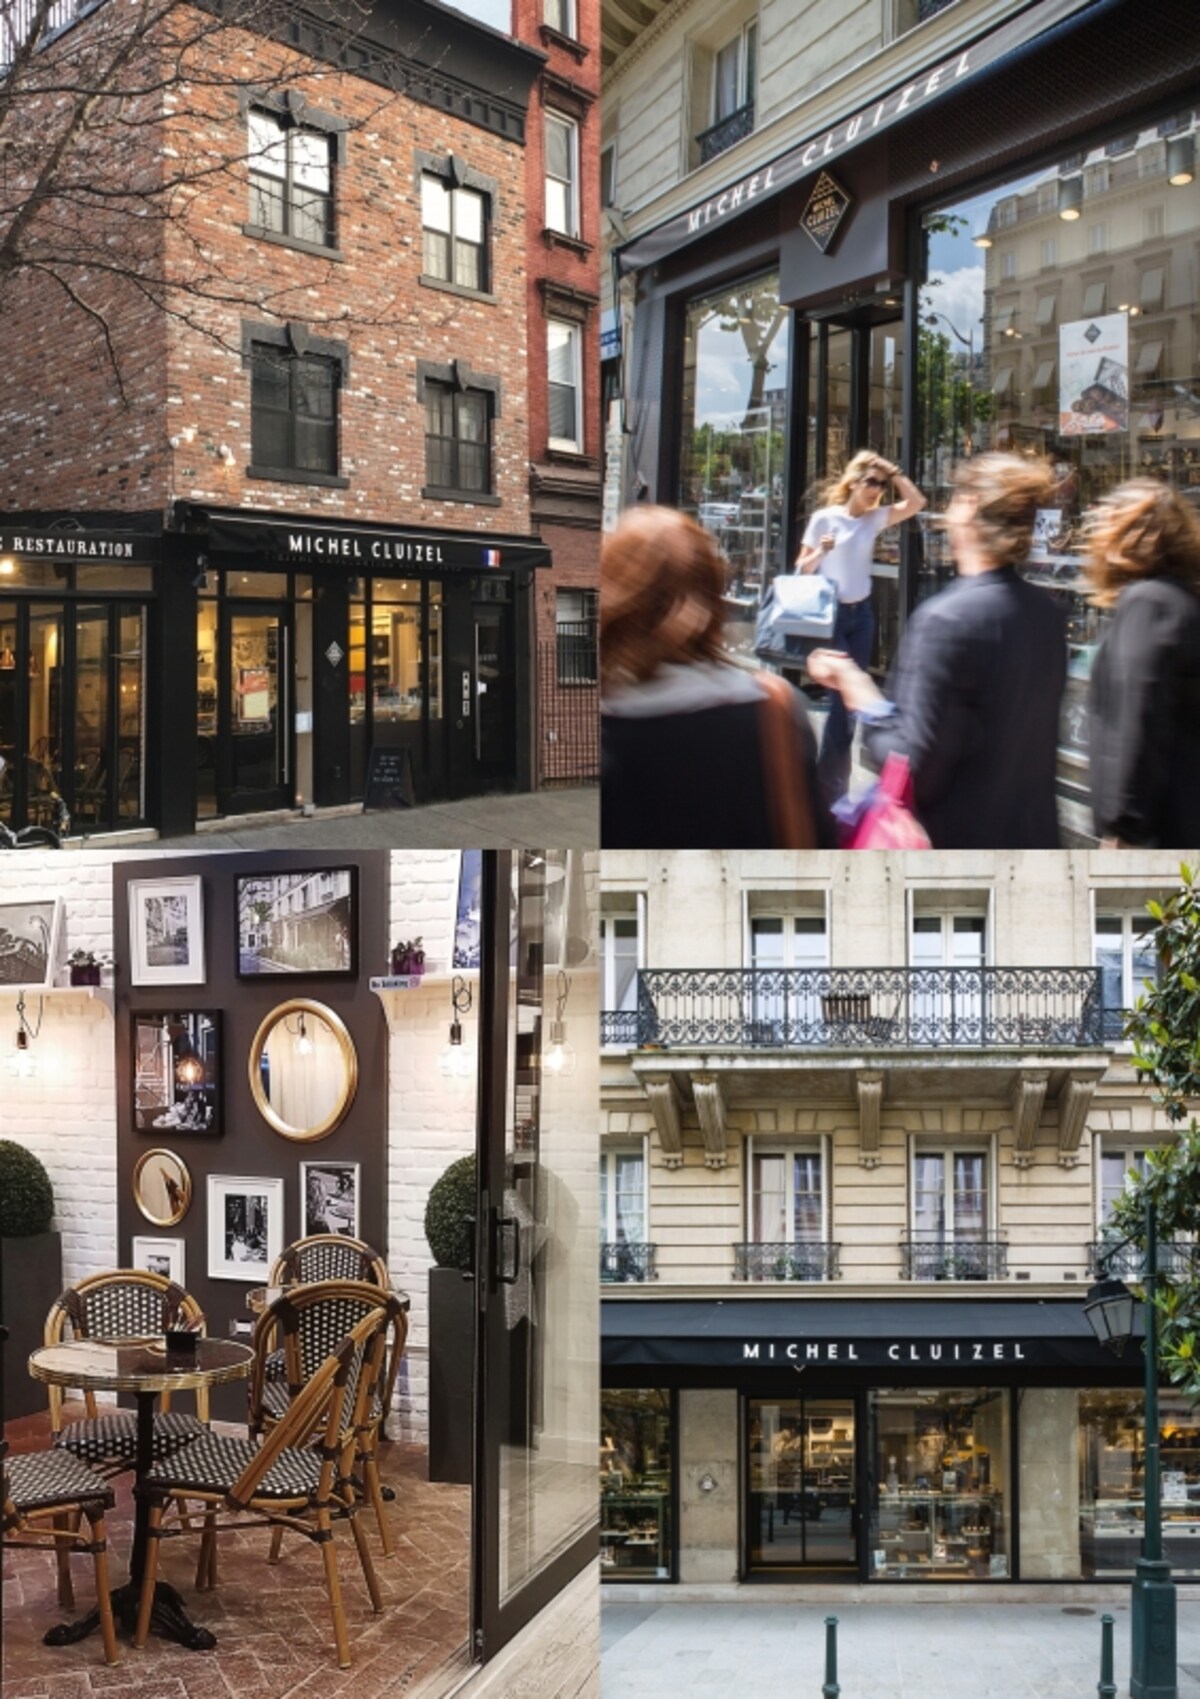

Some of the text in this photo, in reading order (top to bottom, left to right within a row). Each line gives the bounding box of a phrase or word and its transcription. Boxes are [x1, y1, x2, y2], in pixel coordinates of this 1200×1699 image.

[687, 52, 970, 235] MICHEL CLUIZEL
[12, 536, 134, 558] RESTAURATION
[288, 534, 362, 558] MICHEL
[370, 540, 444, 563] CLUIZEL
[743, 1343, 1026, 1361] MICHEL CLUIZEL
